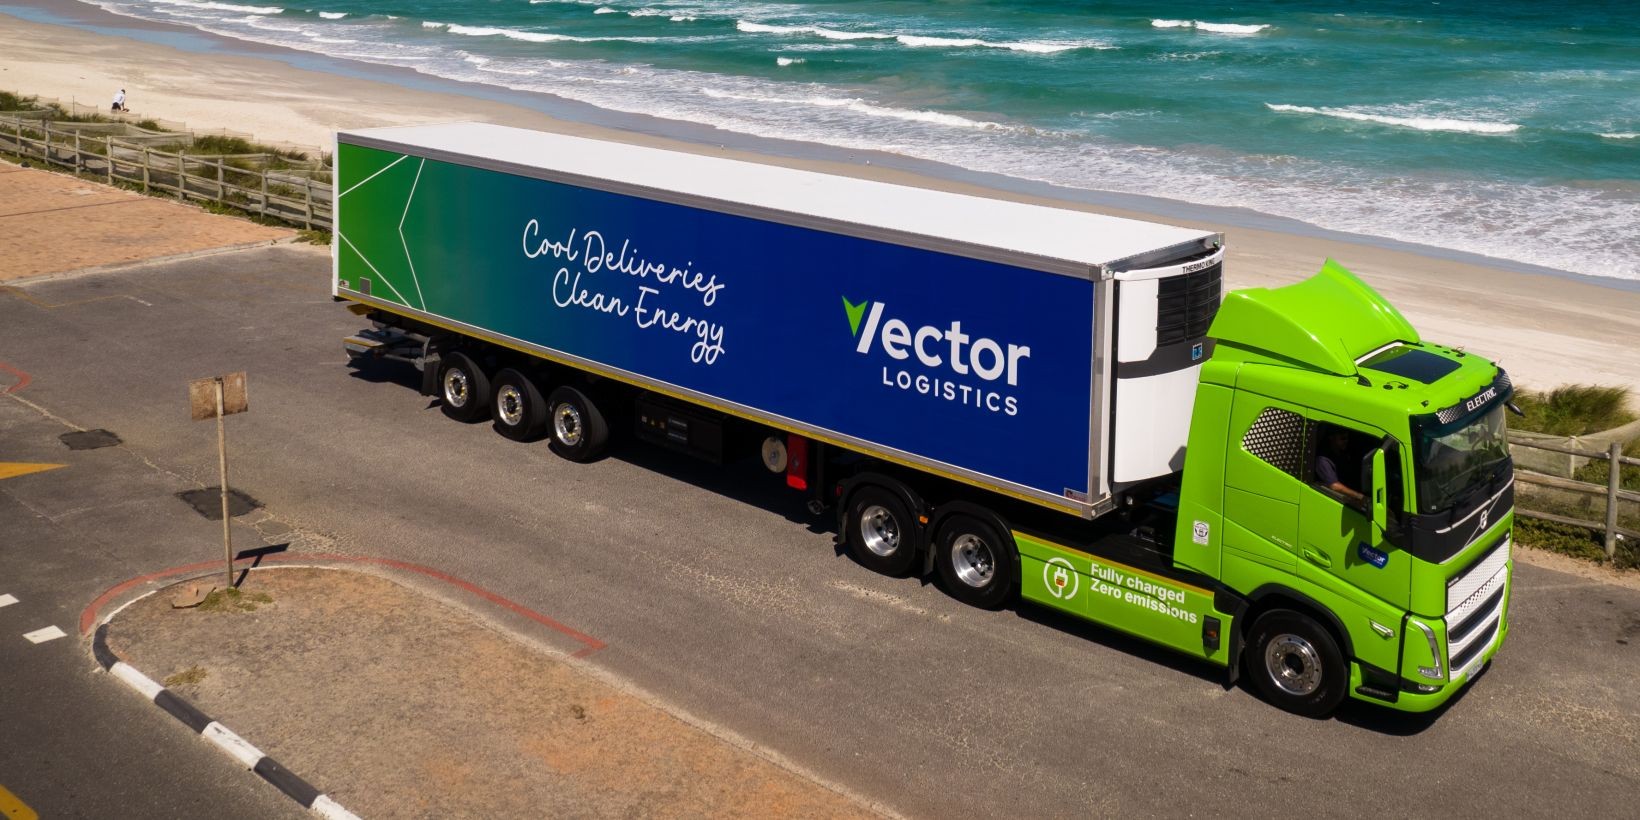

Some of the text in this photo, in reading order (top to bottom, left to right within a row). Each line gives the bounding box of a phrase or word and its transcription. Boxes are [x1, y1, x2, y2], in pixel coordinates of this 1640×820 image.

[523, 219, 725, 307] Cool Deliveries
[553, 268, 725, 365] Clean Energy
[841, 295, 1030, 386] Vector
[882, 366, 1018, 416] LOGISTICS
[1466, 387, 1497, 412] ELECTRIC
[1090, 563, 1185, 604] Fully charged
[1090, 578, 1198, 624] Zero emissions
